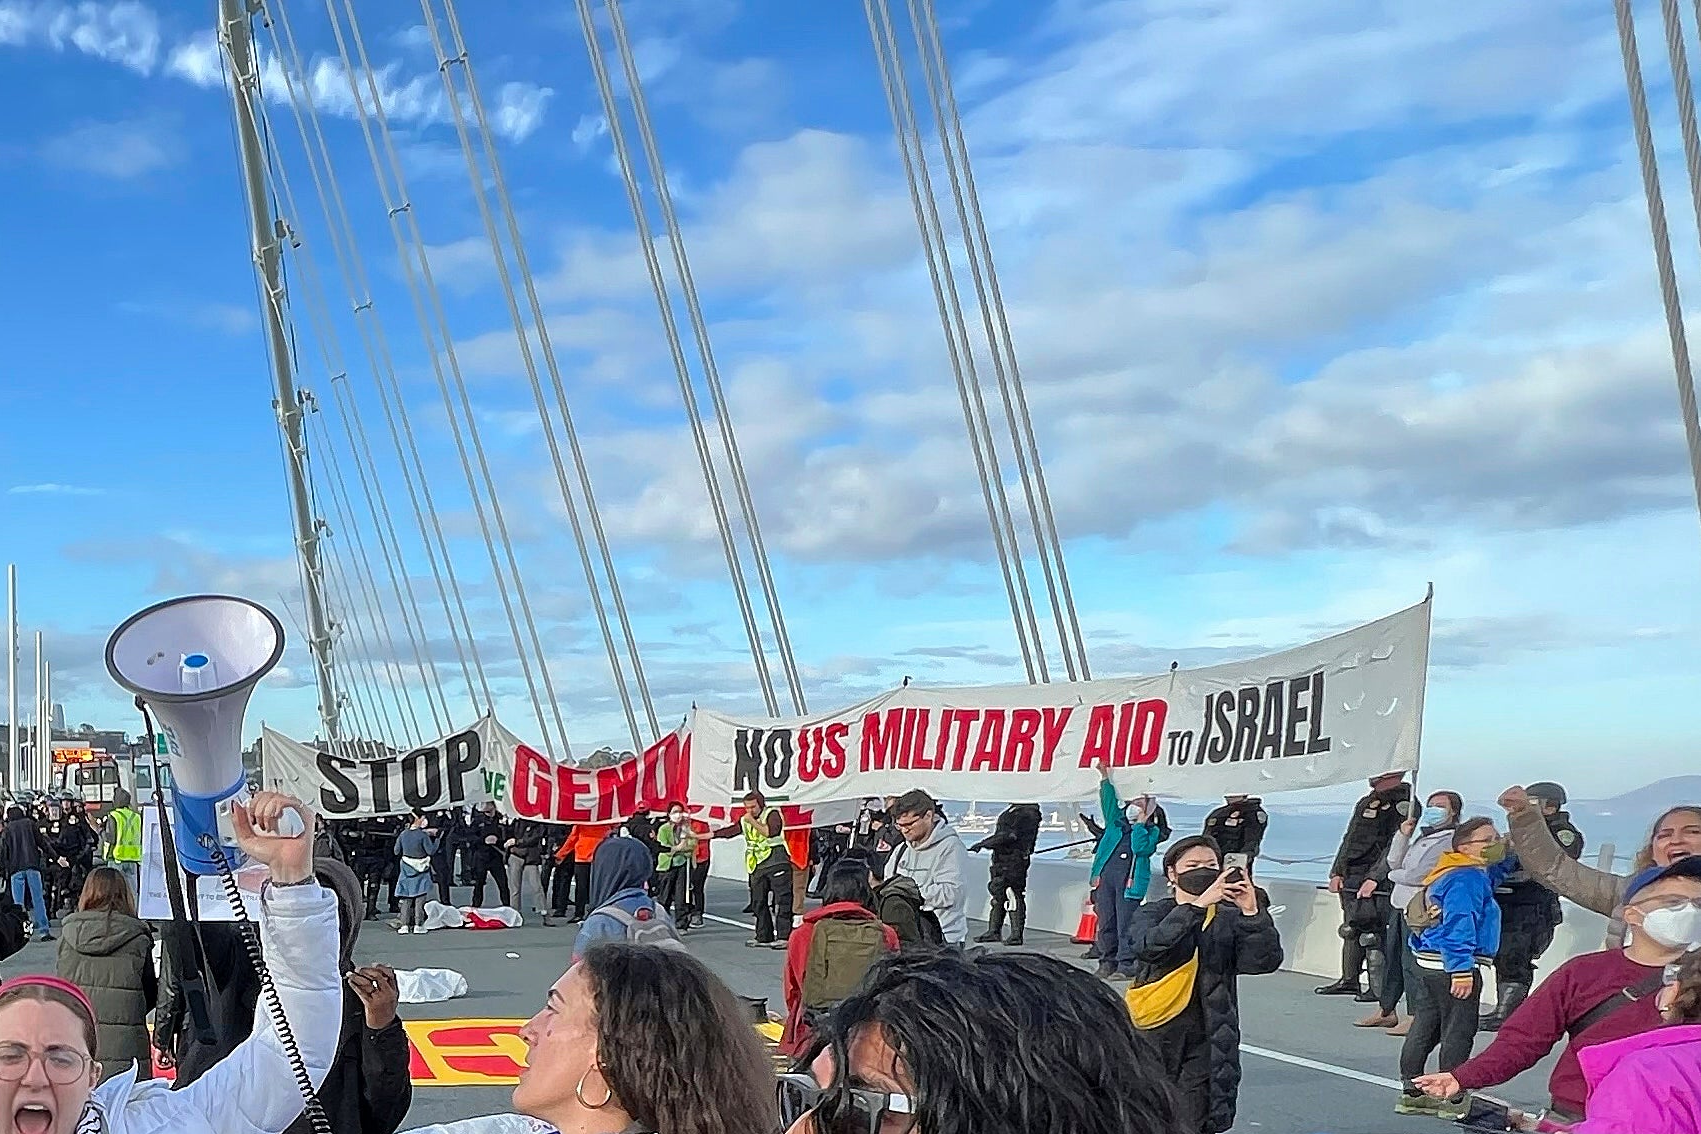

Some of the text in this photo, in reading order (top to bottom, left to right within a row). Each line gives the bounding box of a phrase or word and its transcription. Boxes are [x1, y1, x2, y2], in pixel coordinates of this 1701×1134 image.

[315, 729, 483, 814] STOP
[733, 670, 1332, 792] NO US MILITARY AID TO ISRAEL
